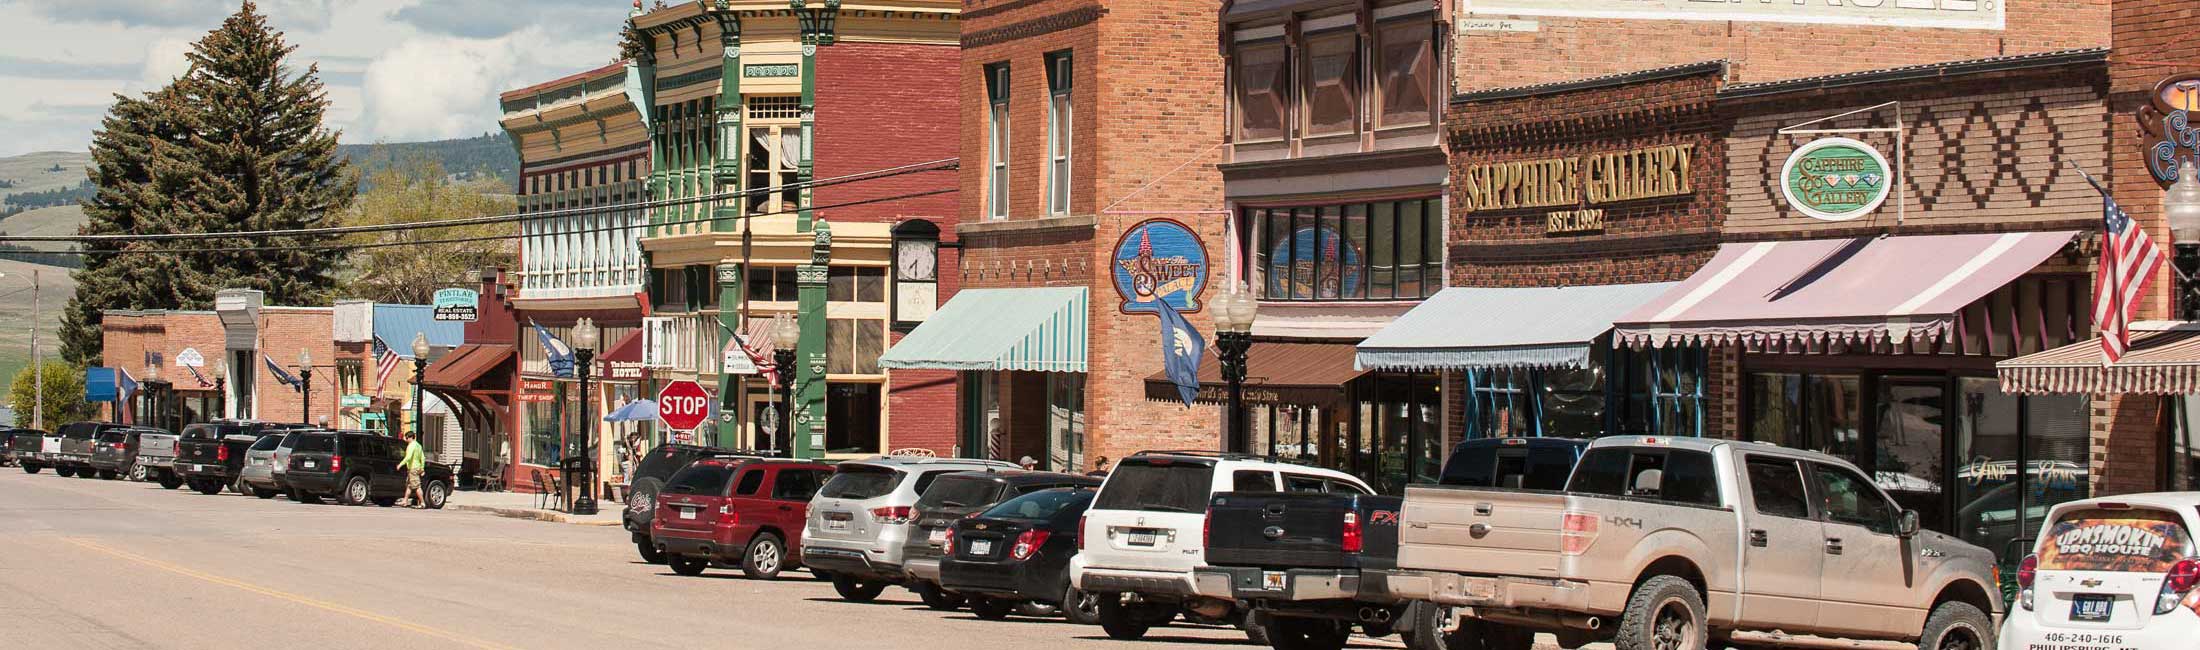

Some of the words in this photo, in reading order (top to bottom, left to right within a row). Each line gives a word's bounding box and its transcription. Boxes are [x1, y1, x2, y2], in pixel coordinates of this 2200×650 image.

[1466, 157, 1579, 212] SAPPHIRE
[1585, 144, 1693, 204] GALLERY
[1547, 211, 1574, 232] EST.
[1575, 209, 1604, 230] 1992
[612, 368, 642, 378] HOTEL
[661, 395, 706, 415] STOP
[2060, 544, 2091, 555] BBQ
[2094, 544, 2152, 556] HOUSE
[2045, 633, 2122, 644] 406-240-1616
